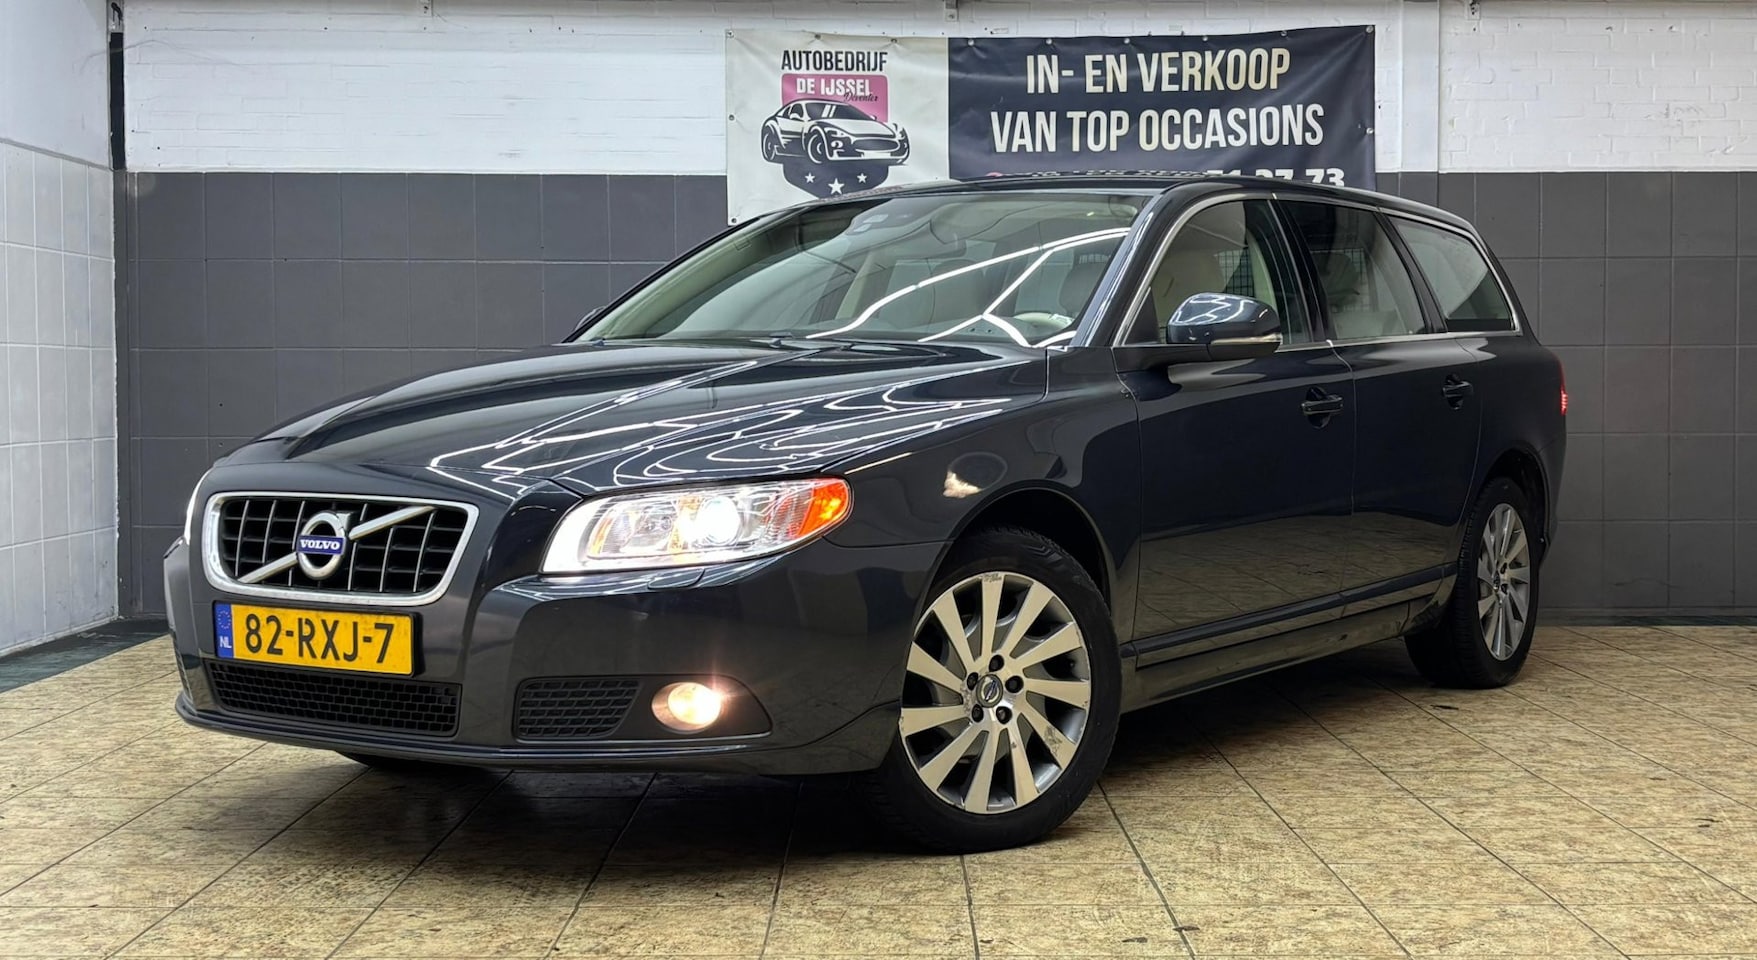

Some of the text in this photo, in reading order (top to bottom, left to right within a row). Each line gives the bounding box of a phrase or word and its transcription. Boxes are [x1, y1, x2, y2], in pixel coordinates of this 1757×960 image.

[781, 50, 888, 71] AUTOBEDRIJF
[1026, 48, 1291, 94] IN- EN VERKOOP
[796, 78, 871, 96] DE IJSSEL
[990, 103, 1325, 153] VAN TOP OCCASIONS
[300, 538, 340, 551] VOLVO
[220, 636, 231, 650] NL
[244, 613, 395, 664] 82-RXJ-7
